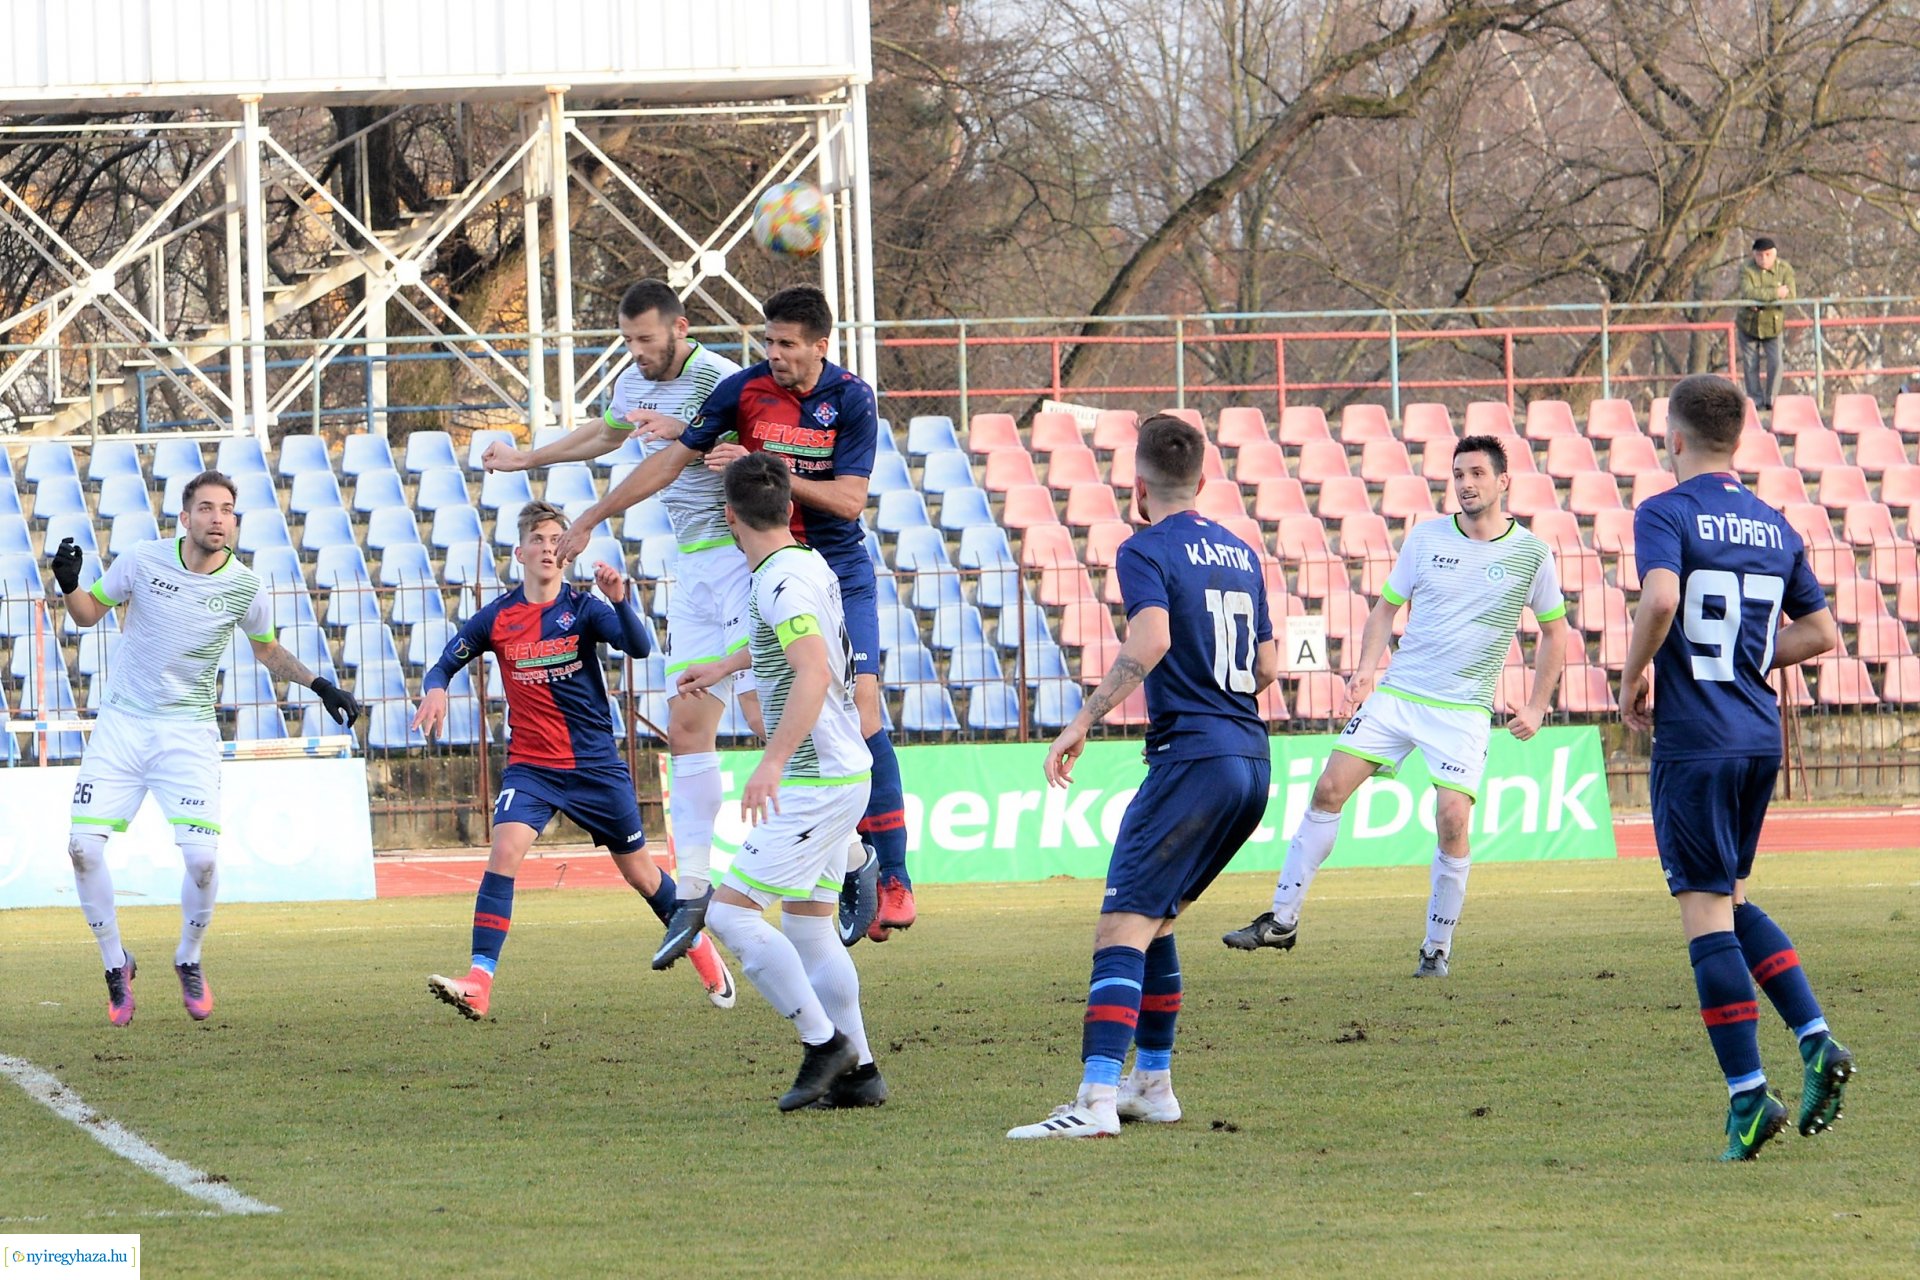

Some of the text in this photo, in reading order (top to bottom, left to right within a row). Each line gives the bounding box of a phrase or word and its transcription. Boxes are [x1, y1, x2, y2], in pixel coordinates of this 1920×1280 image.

[1695, 512, 1784, 550] GYÖRGYI
[1184, 537, 1254, 573] KÁRTIK
[1432, 554, 1460, 565] Zeus
[150, 577, 180, 592] Zeus
[789, 614, 809, 635] C
[1683, 569, 1785, 682] 97
[1204, 588, 1256, 694] 10
[1296, 639, 1317, 665] A
[1440, 762, 1466, 774] Zeus
[73, 782, 93, 804] 26
[1431, 913, 1457, 927] Zeus
